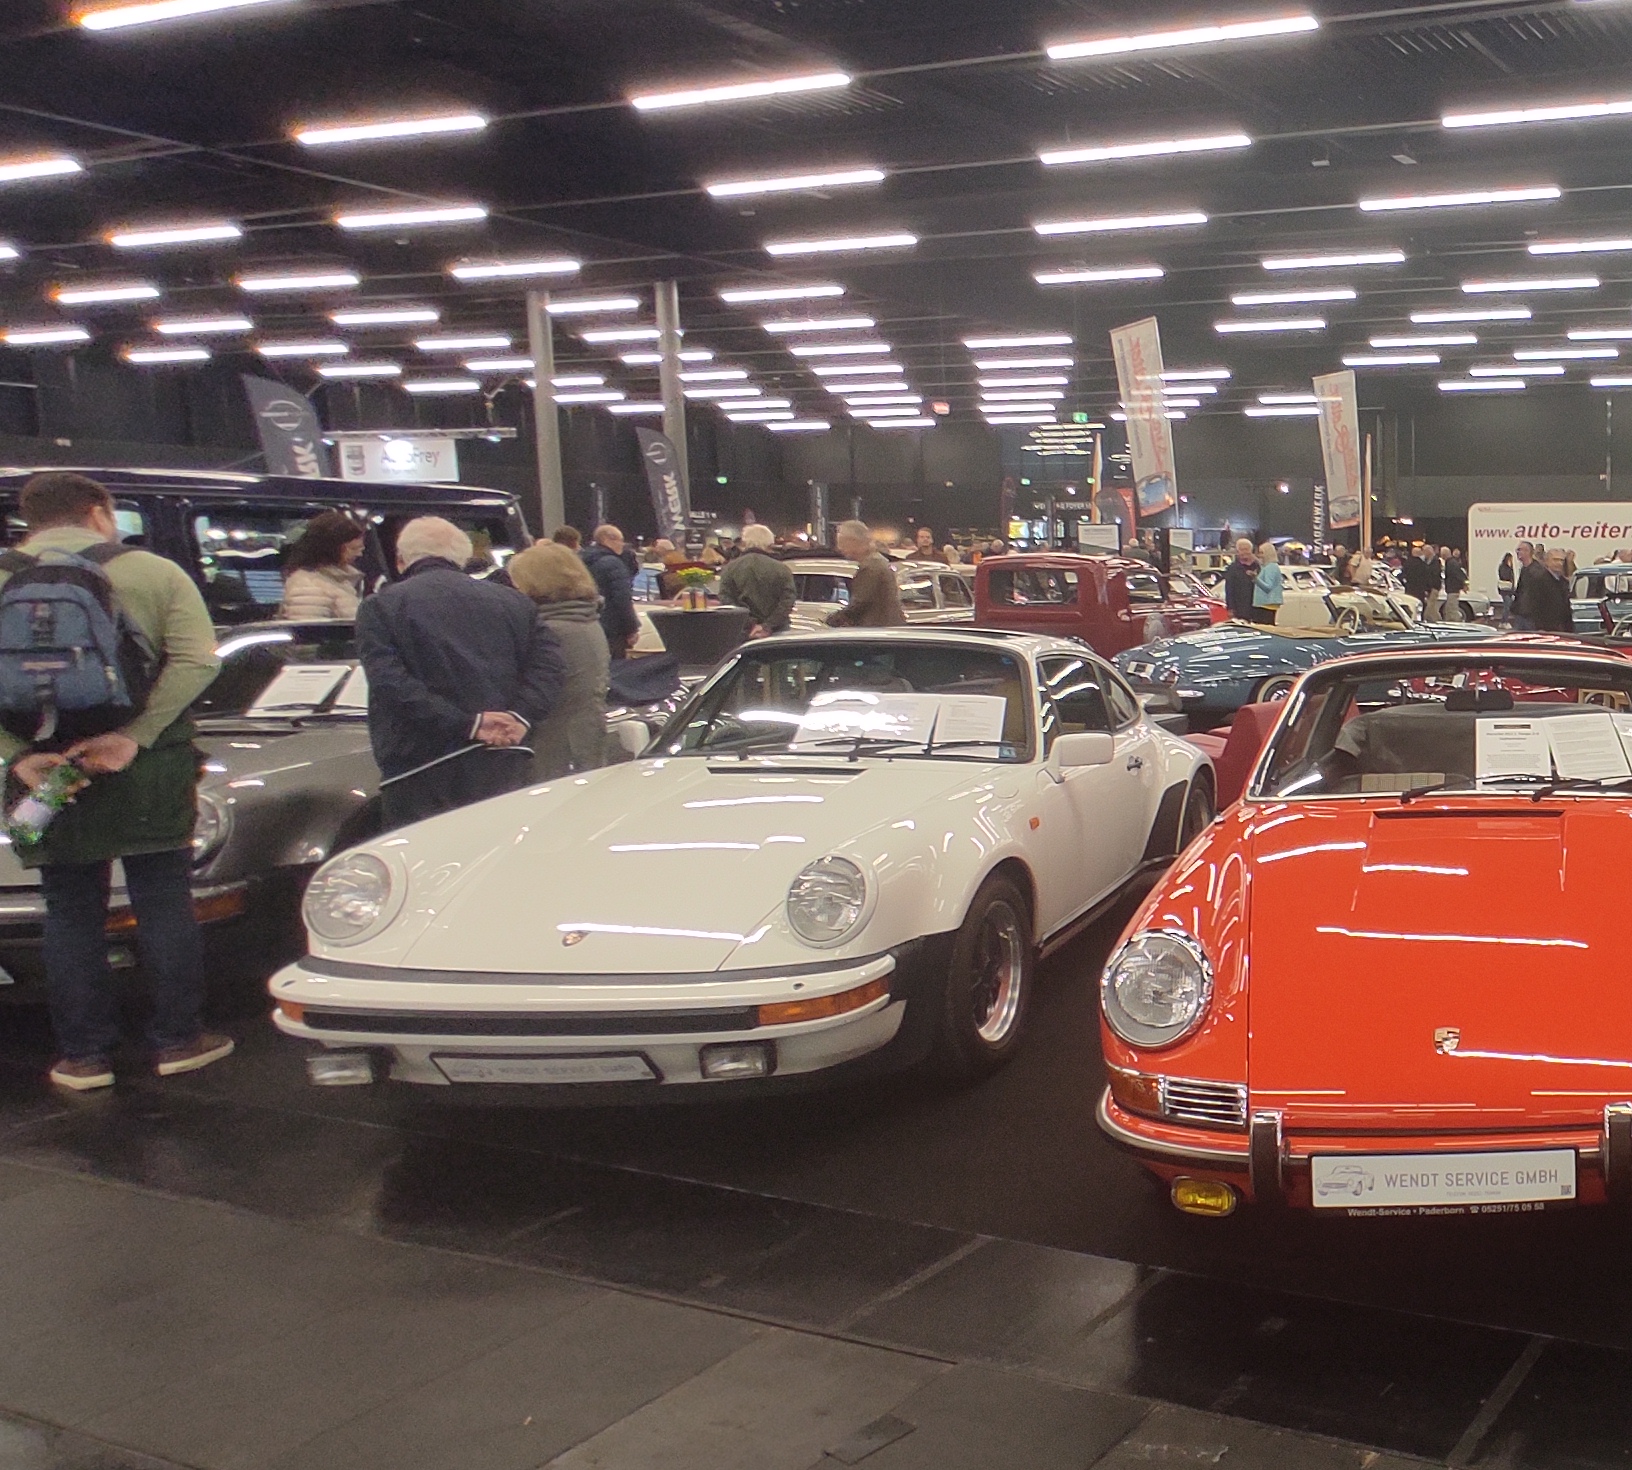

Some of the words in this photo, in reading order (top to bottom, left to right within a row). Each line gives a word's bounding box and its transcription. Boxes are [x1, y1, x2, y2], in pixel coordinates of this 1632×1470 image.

[1384, 1173, 1439, 1189] WENDT
[1445, 1171, 1509, 1187] SERVICE
[1515, 1169, 1559, 1185] GMBH
[1347, 1207, 1411, 1217] Wendt-Service
[1419, 1206, 1464, 1216] Paderborn
